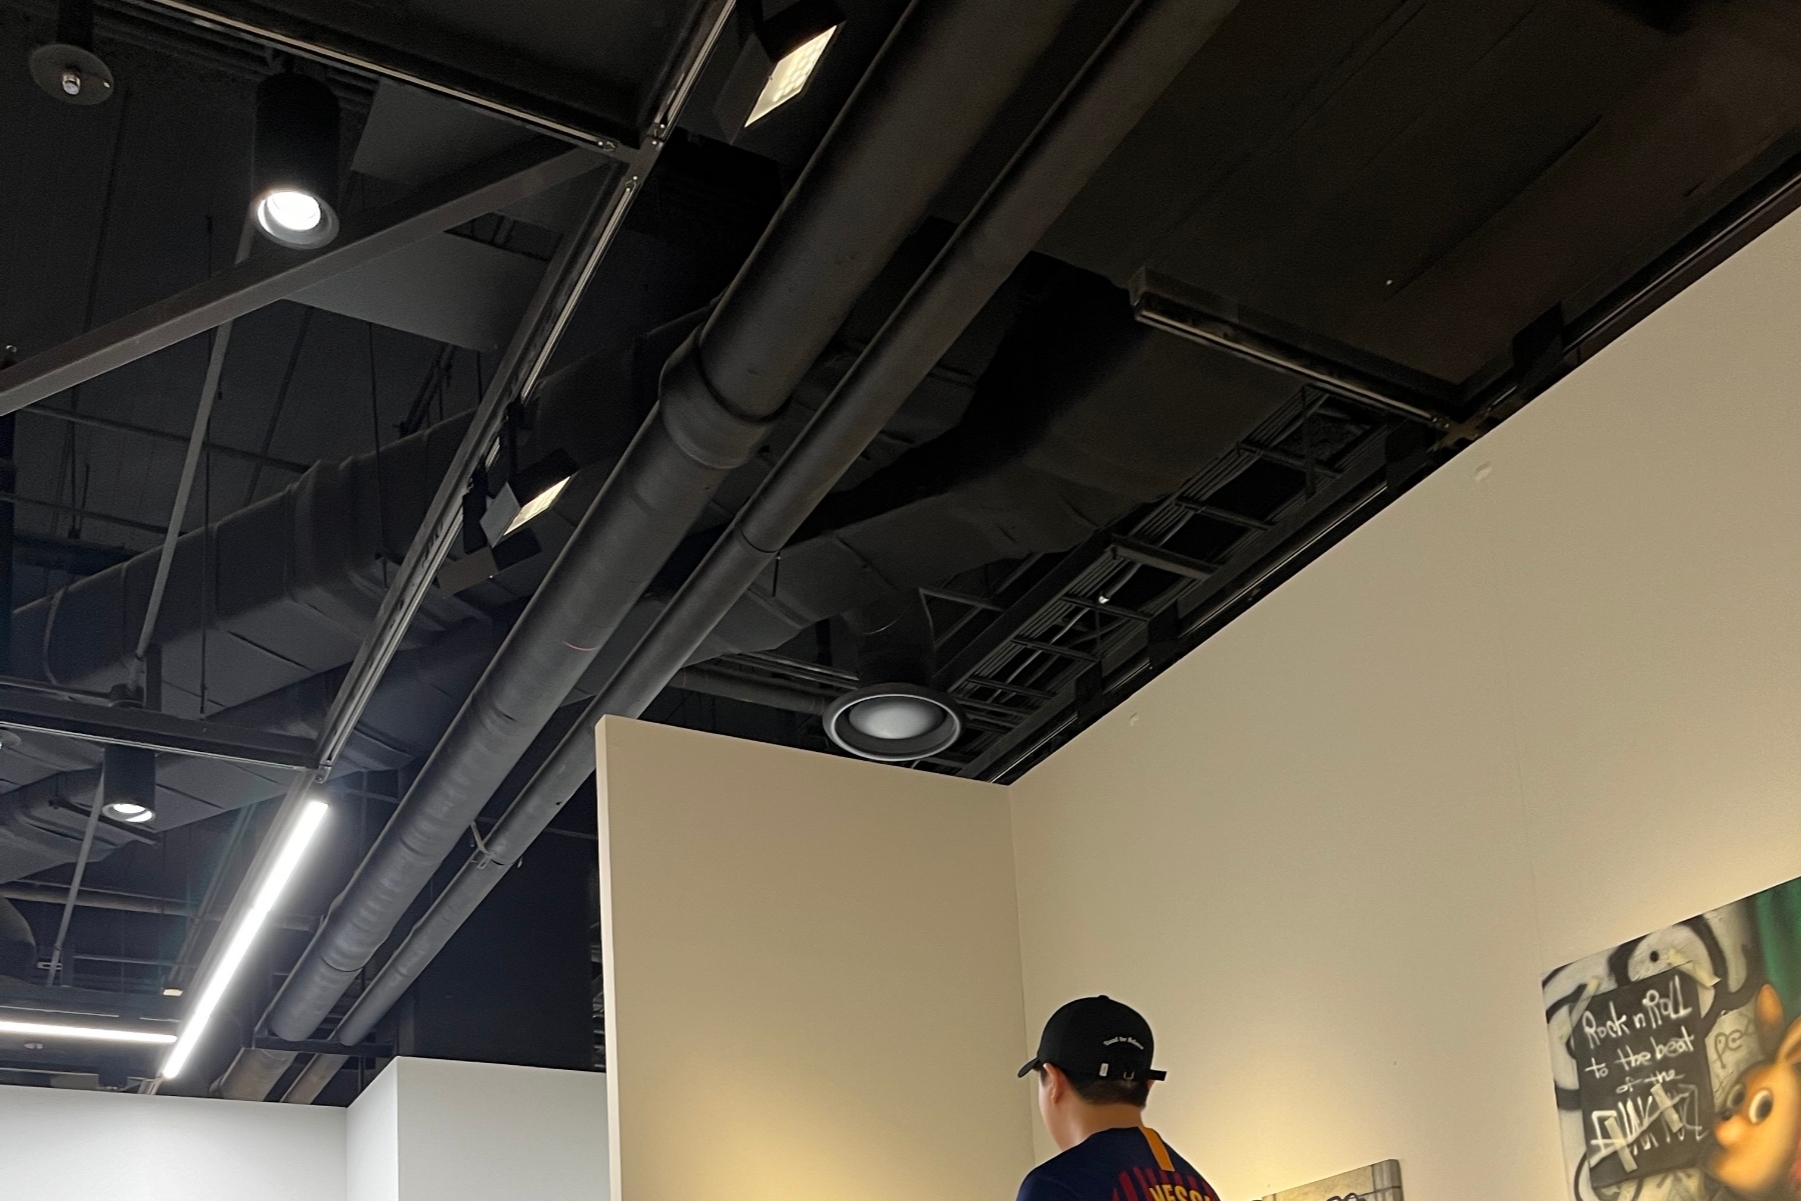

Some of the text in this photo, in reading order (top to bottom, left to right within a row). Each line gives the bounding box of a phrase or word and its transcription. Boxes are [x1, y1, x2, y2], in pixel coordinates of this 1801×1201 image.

[1582, 975, 1692, 1049] Rock n Roll
[1584, 1025, 1694, 1079] to the beat
[1616, 1069, 1686, 1094] of the
